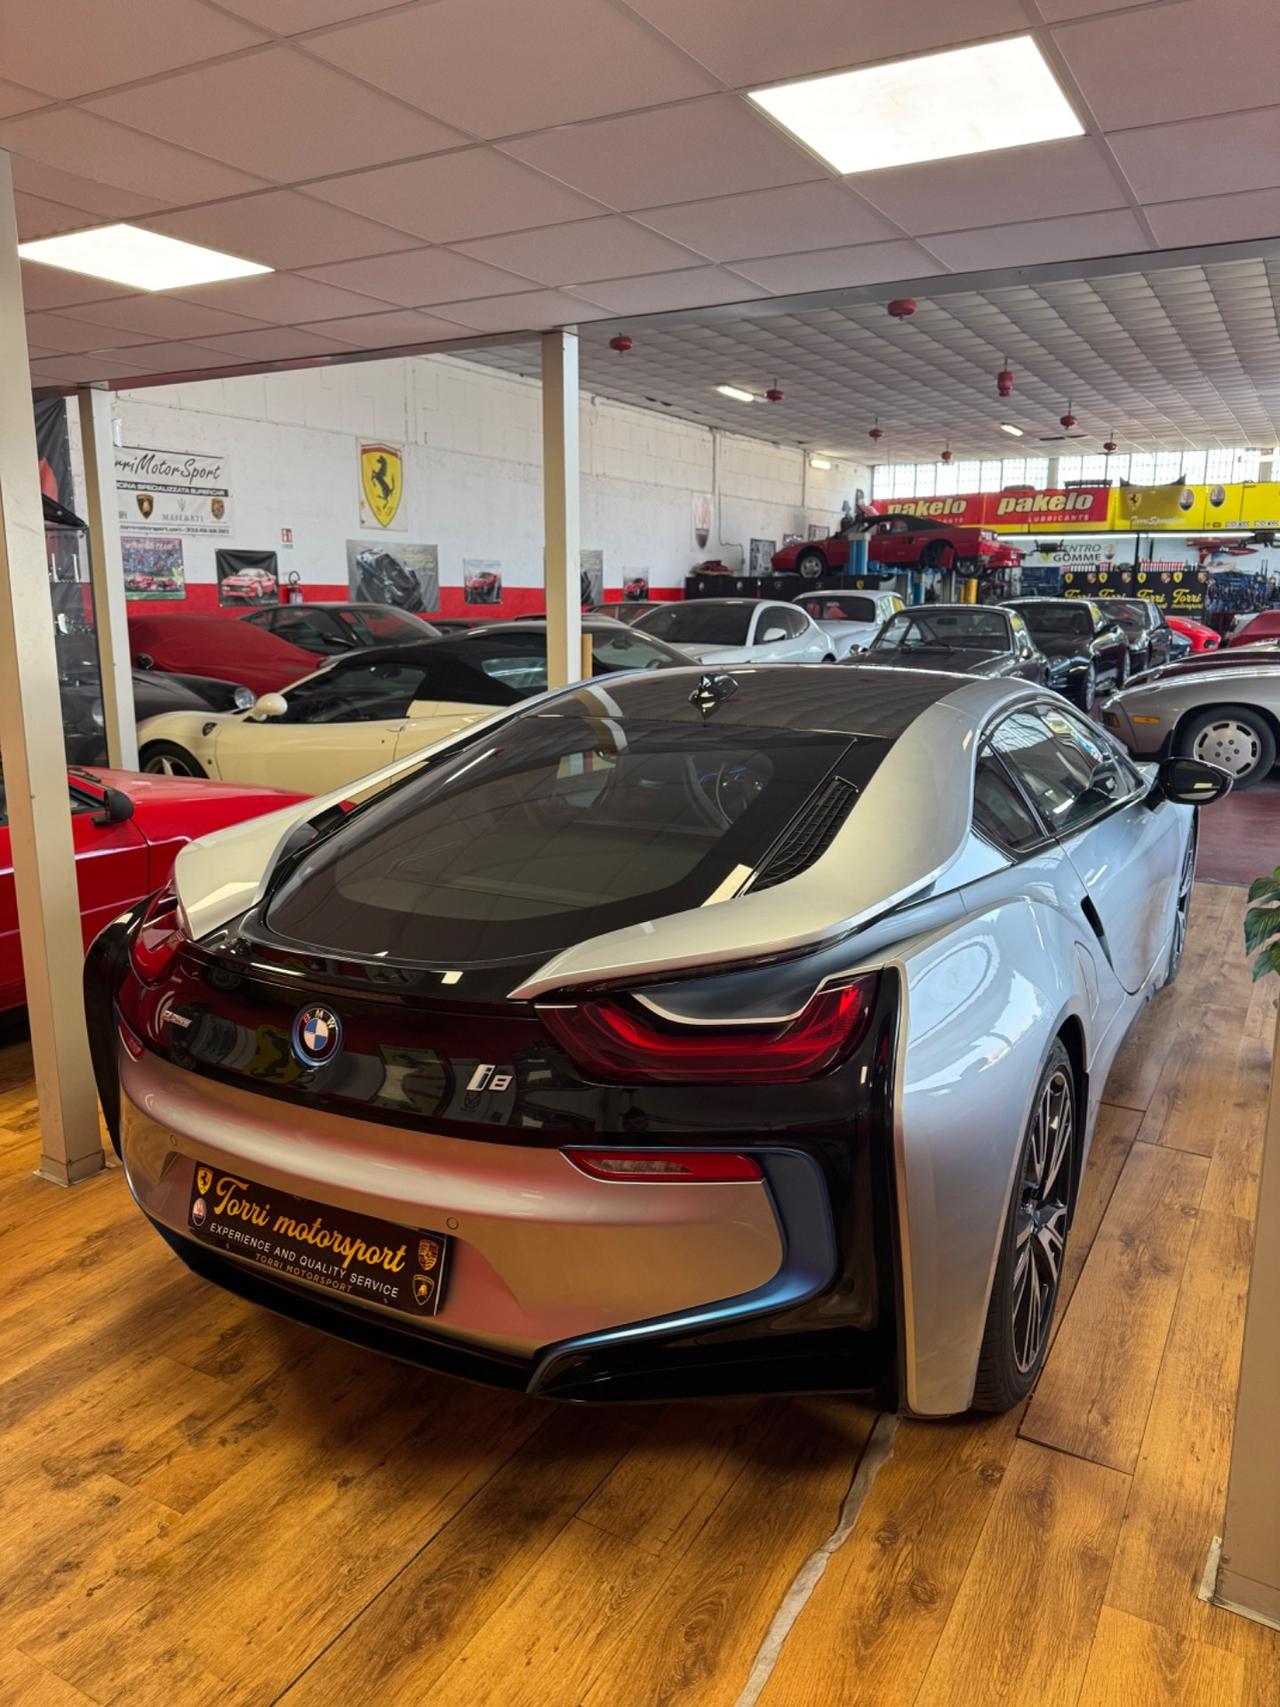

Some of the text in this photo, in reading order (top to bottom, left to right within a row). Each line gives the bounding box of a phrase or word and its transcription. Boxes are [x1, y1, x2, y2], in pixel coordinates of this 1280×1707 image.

[114, 453, 221, 485] rriMotorSport
[997, 492, 1094, 516] pakelo
[1027, 514, 1089, 523] LUBRICANTS
[1053, 552, 1102, 562] GOMME
[1172, 588, 1202, 603] Torri
[303, 1009, 336, 1029] BMW
[466, 1064, 513, 1092] i8
[213, 1176, 407, 1272] Torri motorsport
[210, 1222, 399, 1298] EXPERIENCE AND QUALITY SERVICE
[255, 1253, 353, 1293] TORRI MOTORSPORT
